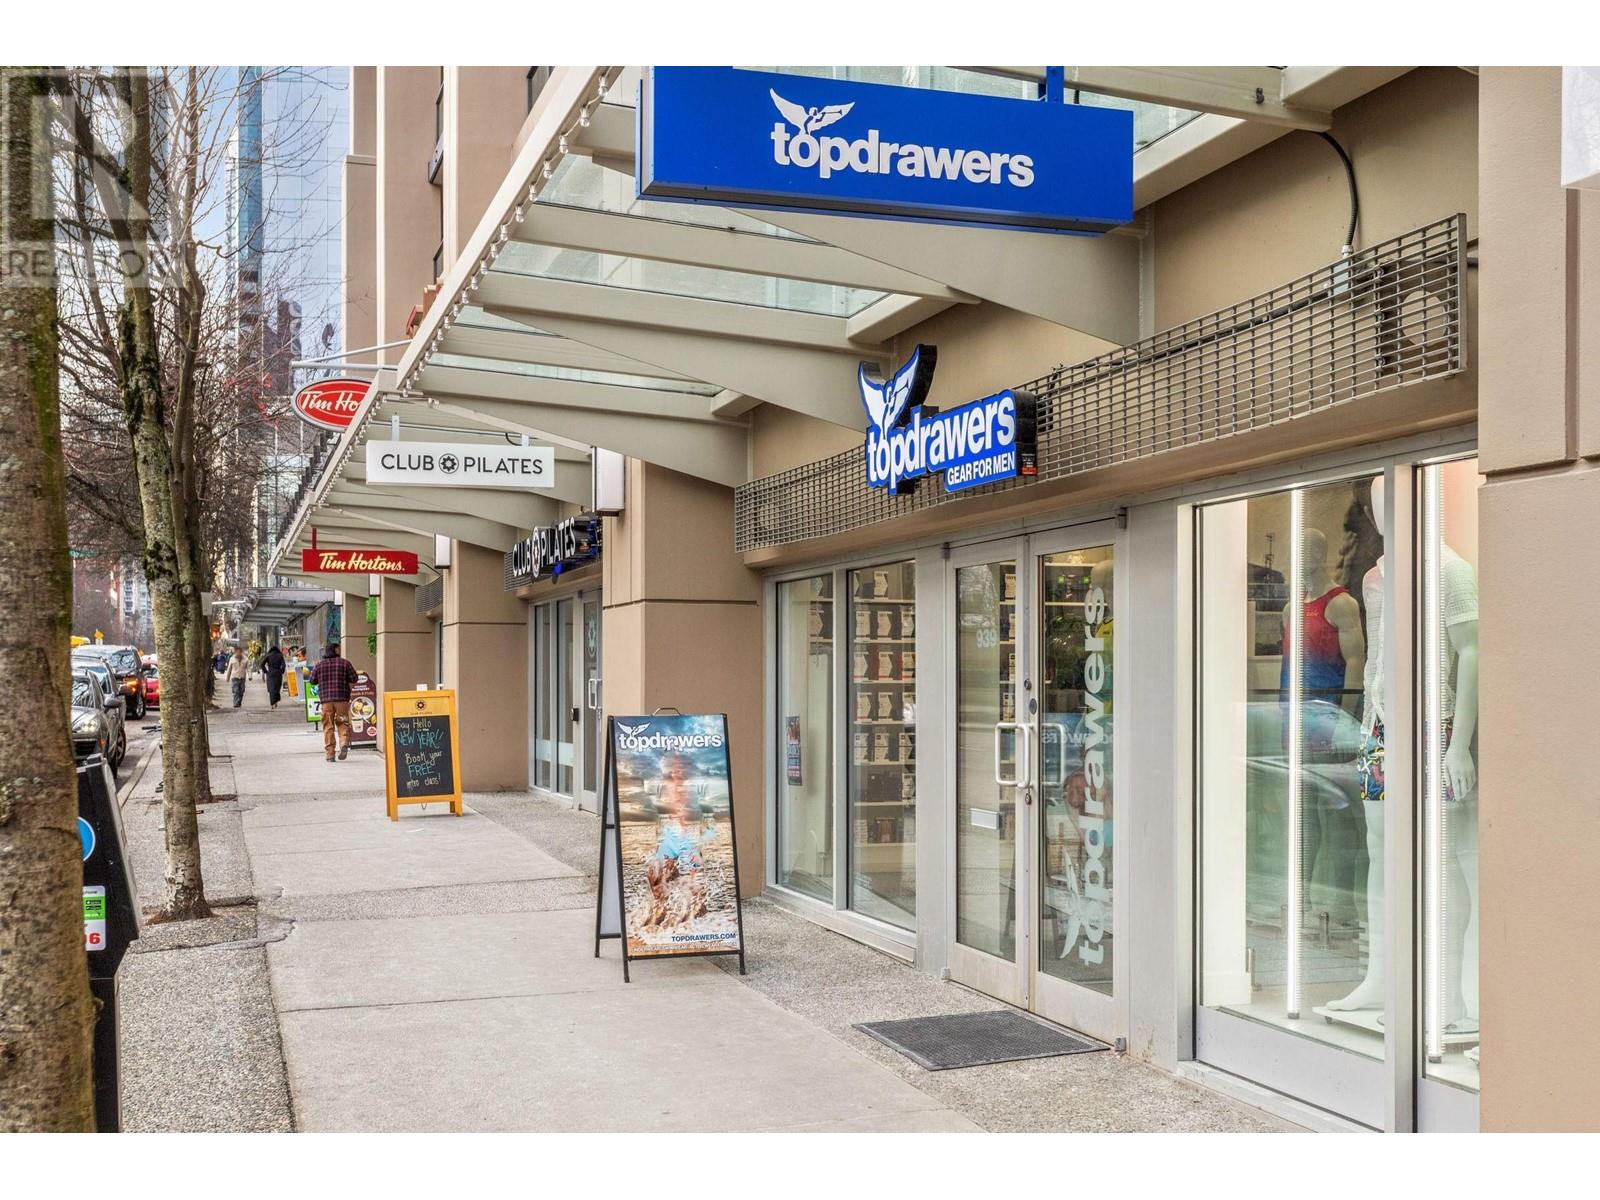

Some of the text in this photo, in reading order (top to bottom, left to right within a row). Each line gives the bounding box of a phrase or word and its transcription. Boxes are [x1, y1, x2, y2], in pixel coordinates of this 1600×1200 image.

[770, 122, 1035, 188] topdrawers
[300, 390, 361, 412] Tim Ho
[867, 396, 1015, 489] topdrawers
[381, 453, 543, 475] CLUB PILATES
[947, 462, 973, 486] GEAR
[973, 458, 992, 480] FOR
[992, 451, 1015, 476] MEN
[512, 516, 576, 577] CLUB PILATES
[319, 552, 346, 570] Tim
[976, 629, 997, 648] 939
[395, 717, 432, 737] Say Hello
[395, 731, 415, 746] NEW
[408, 763, 434, 777] FREE
[1079, 587, 1104, 966] topdrawers
[671, 932, 736, 943] TOPDRAWERS.COM
